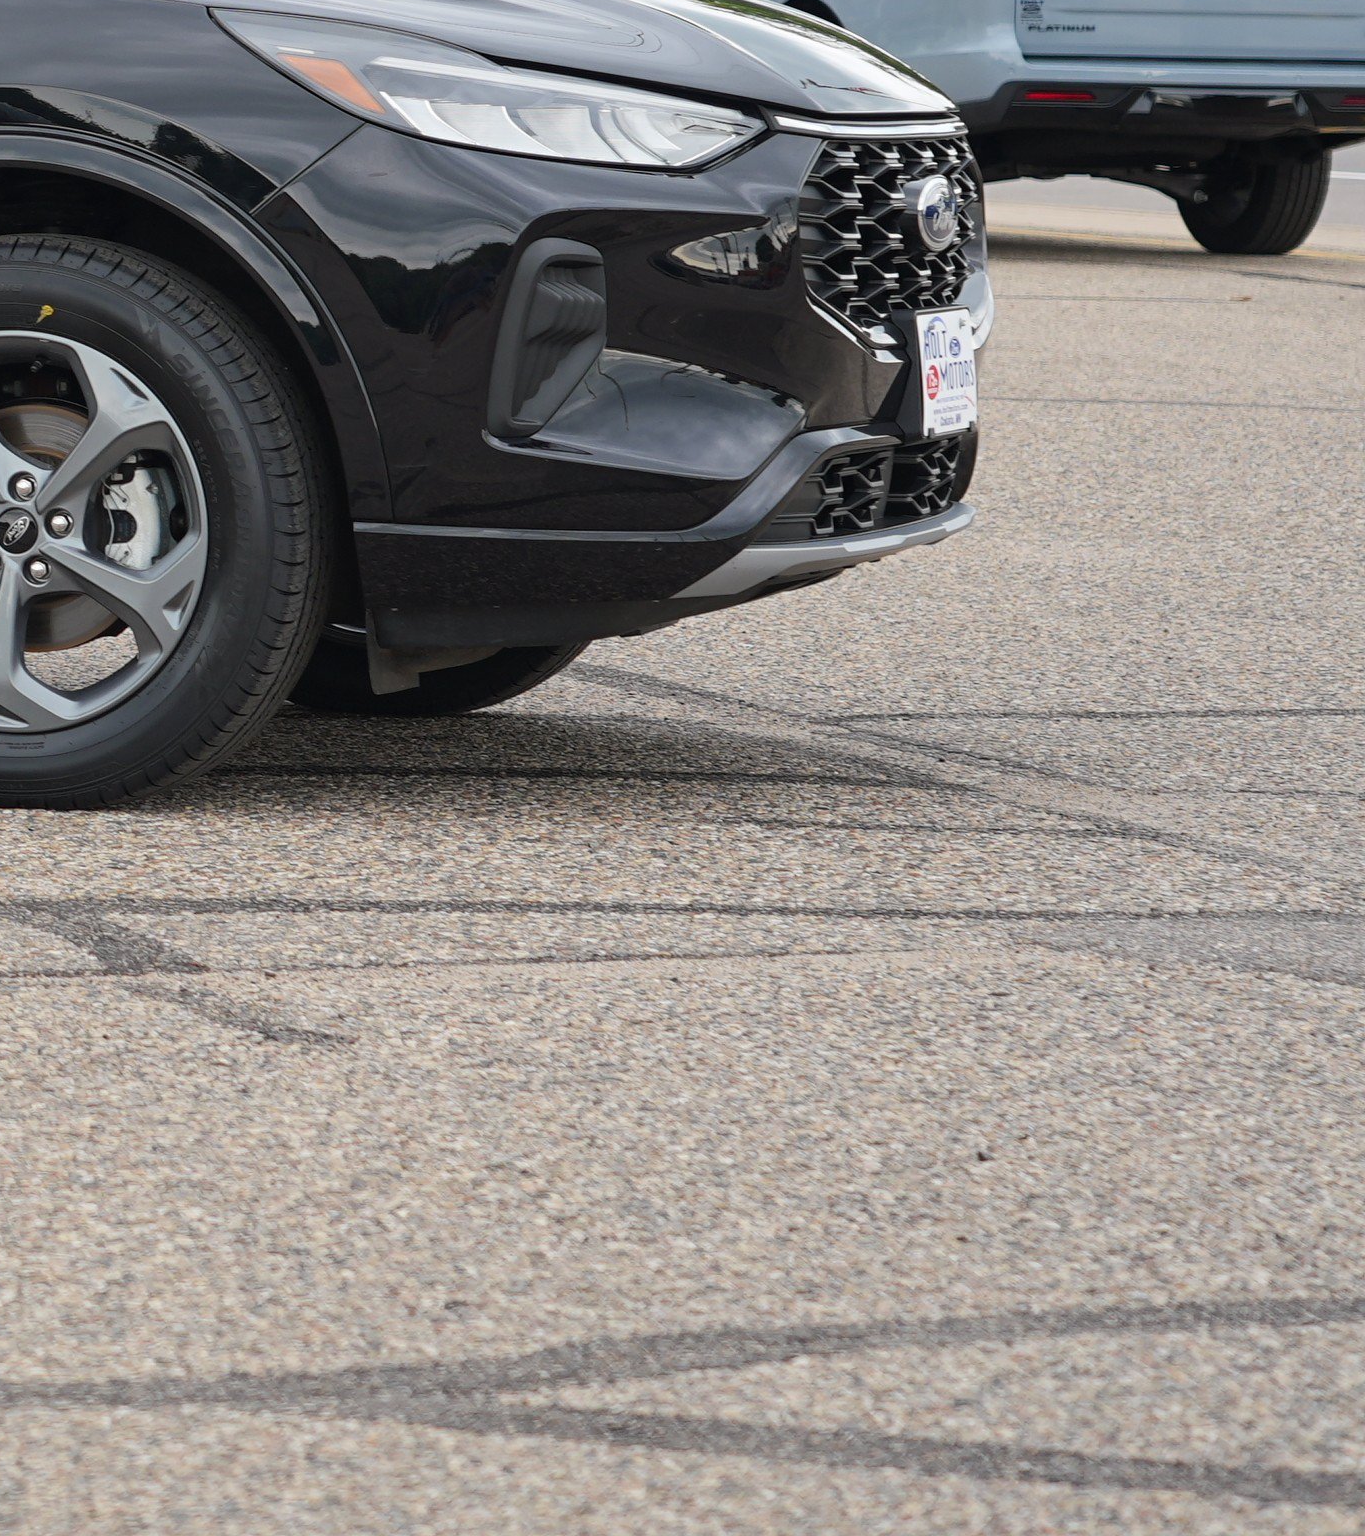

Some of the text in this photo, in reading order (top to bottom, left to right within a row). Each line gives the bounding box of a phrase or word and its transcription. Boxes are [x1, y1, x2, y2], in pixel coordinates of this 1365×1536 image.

[1027, 24, 1096, 33] PLATINUM
[923, 329, 948, 360] HOLT
[938, 359, 975, 391] MOTORS
